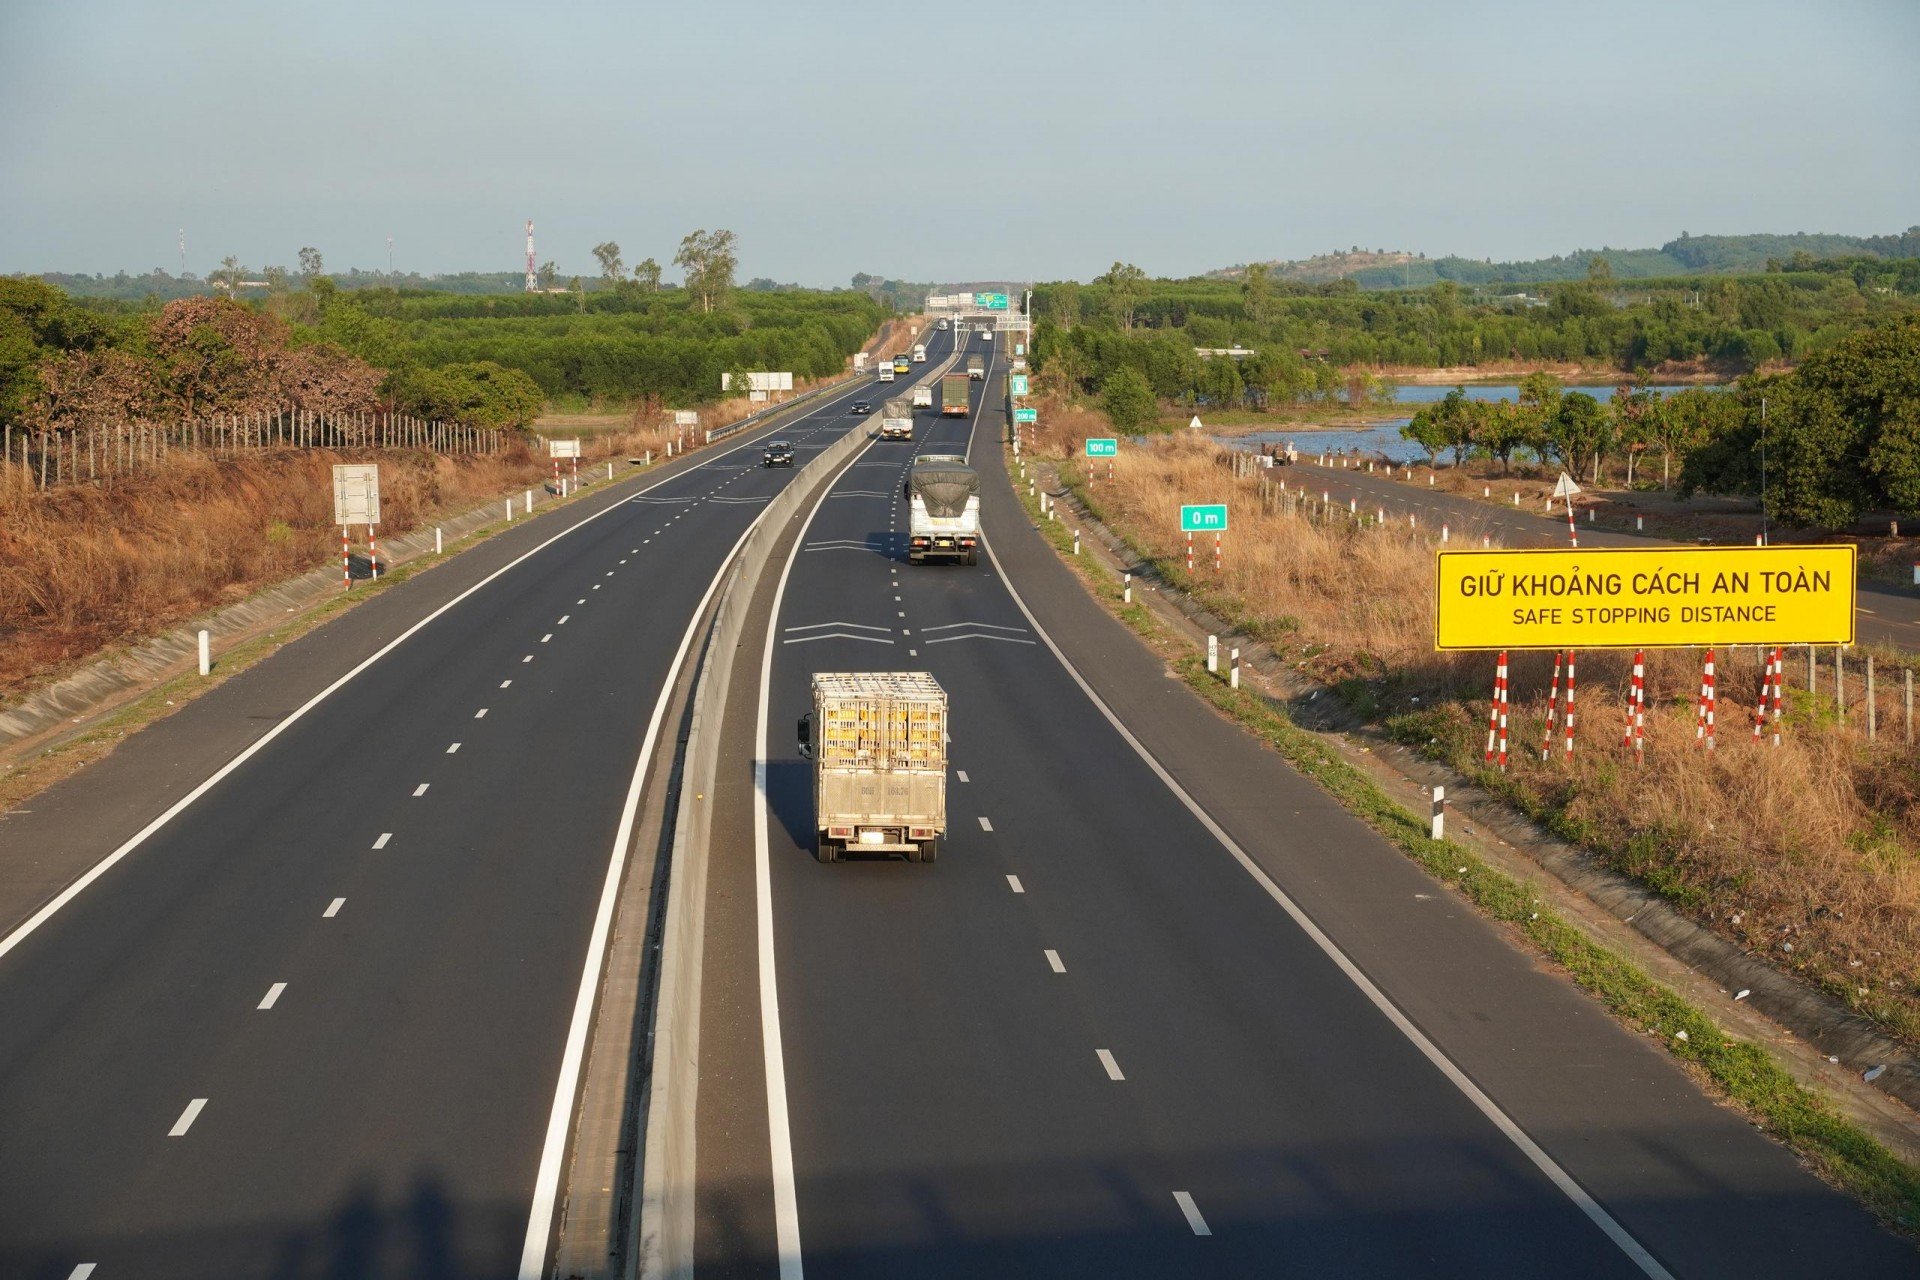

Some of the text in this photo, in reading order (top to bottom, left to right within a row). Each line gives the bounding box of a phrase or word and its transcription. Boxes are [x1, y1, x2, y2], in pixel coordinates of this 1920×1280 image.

[1089, 443, 1115, 453] 100 m
[1192, 511, 1219, 525] 0 m
[1460, 565, 1831, 597] GIỮ KHOẢNG CÁCH AN TOÀN
[1513, 605, 1777, 625] SAFE STOPPING DISTANCE
